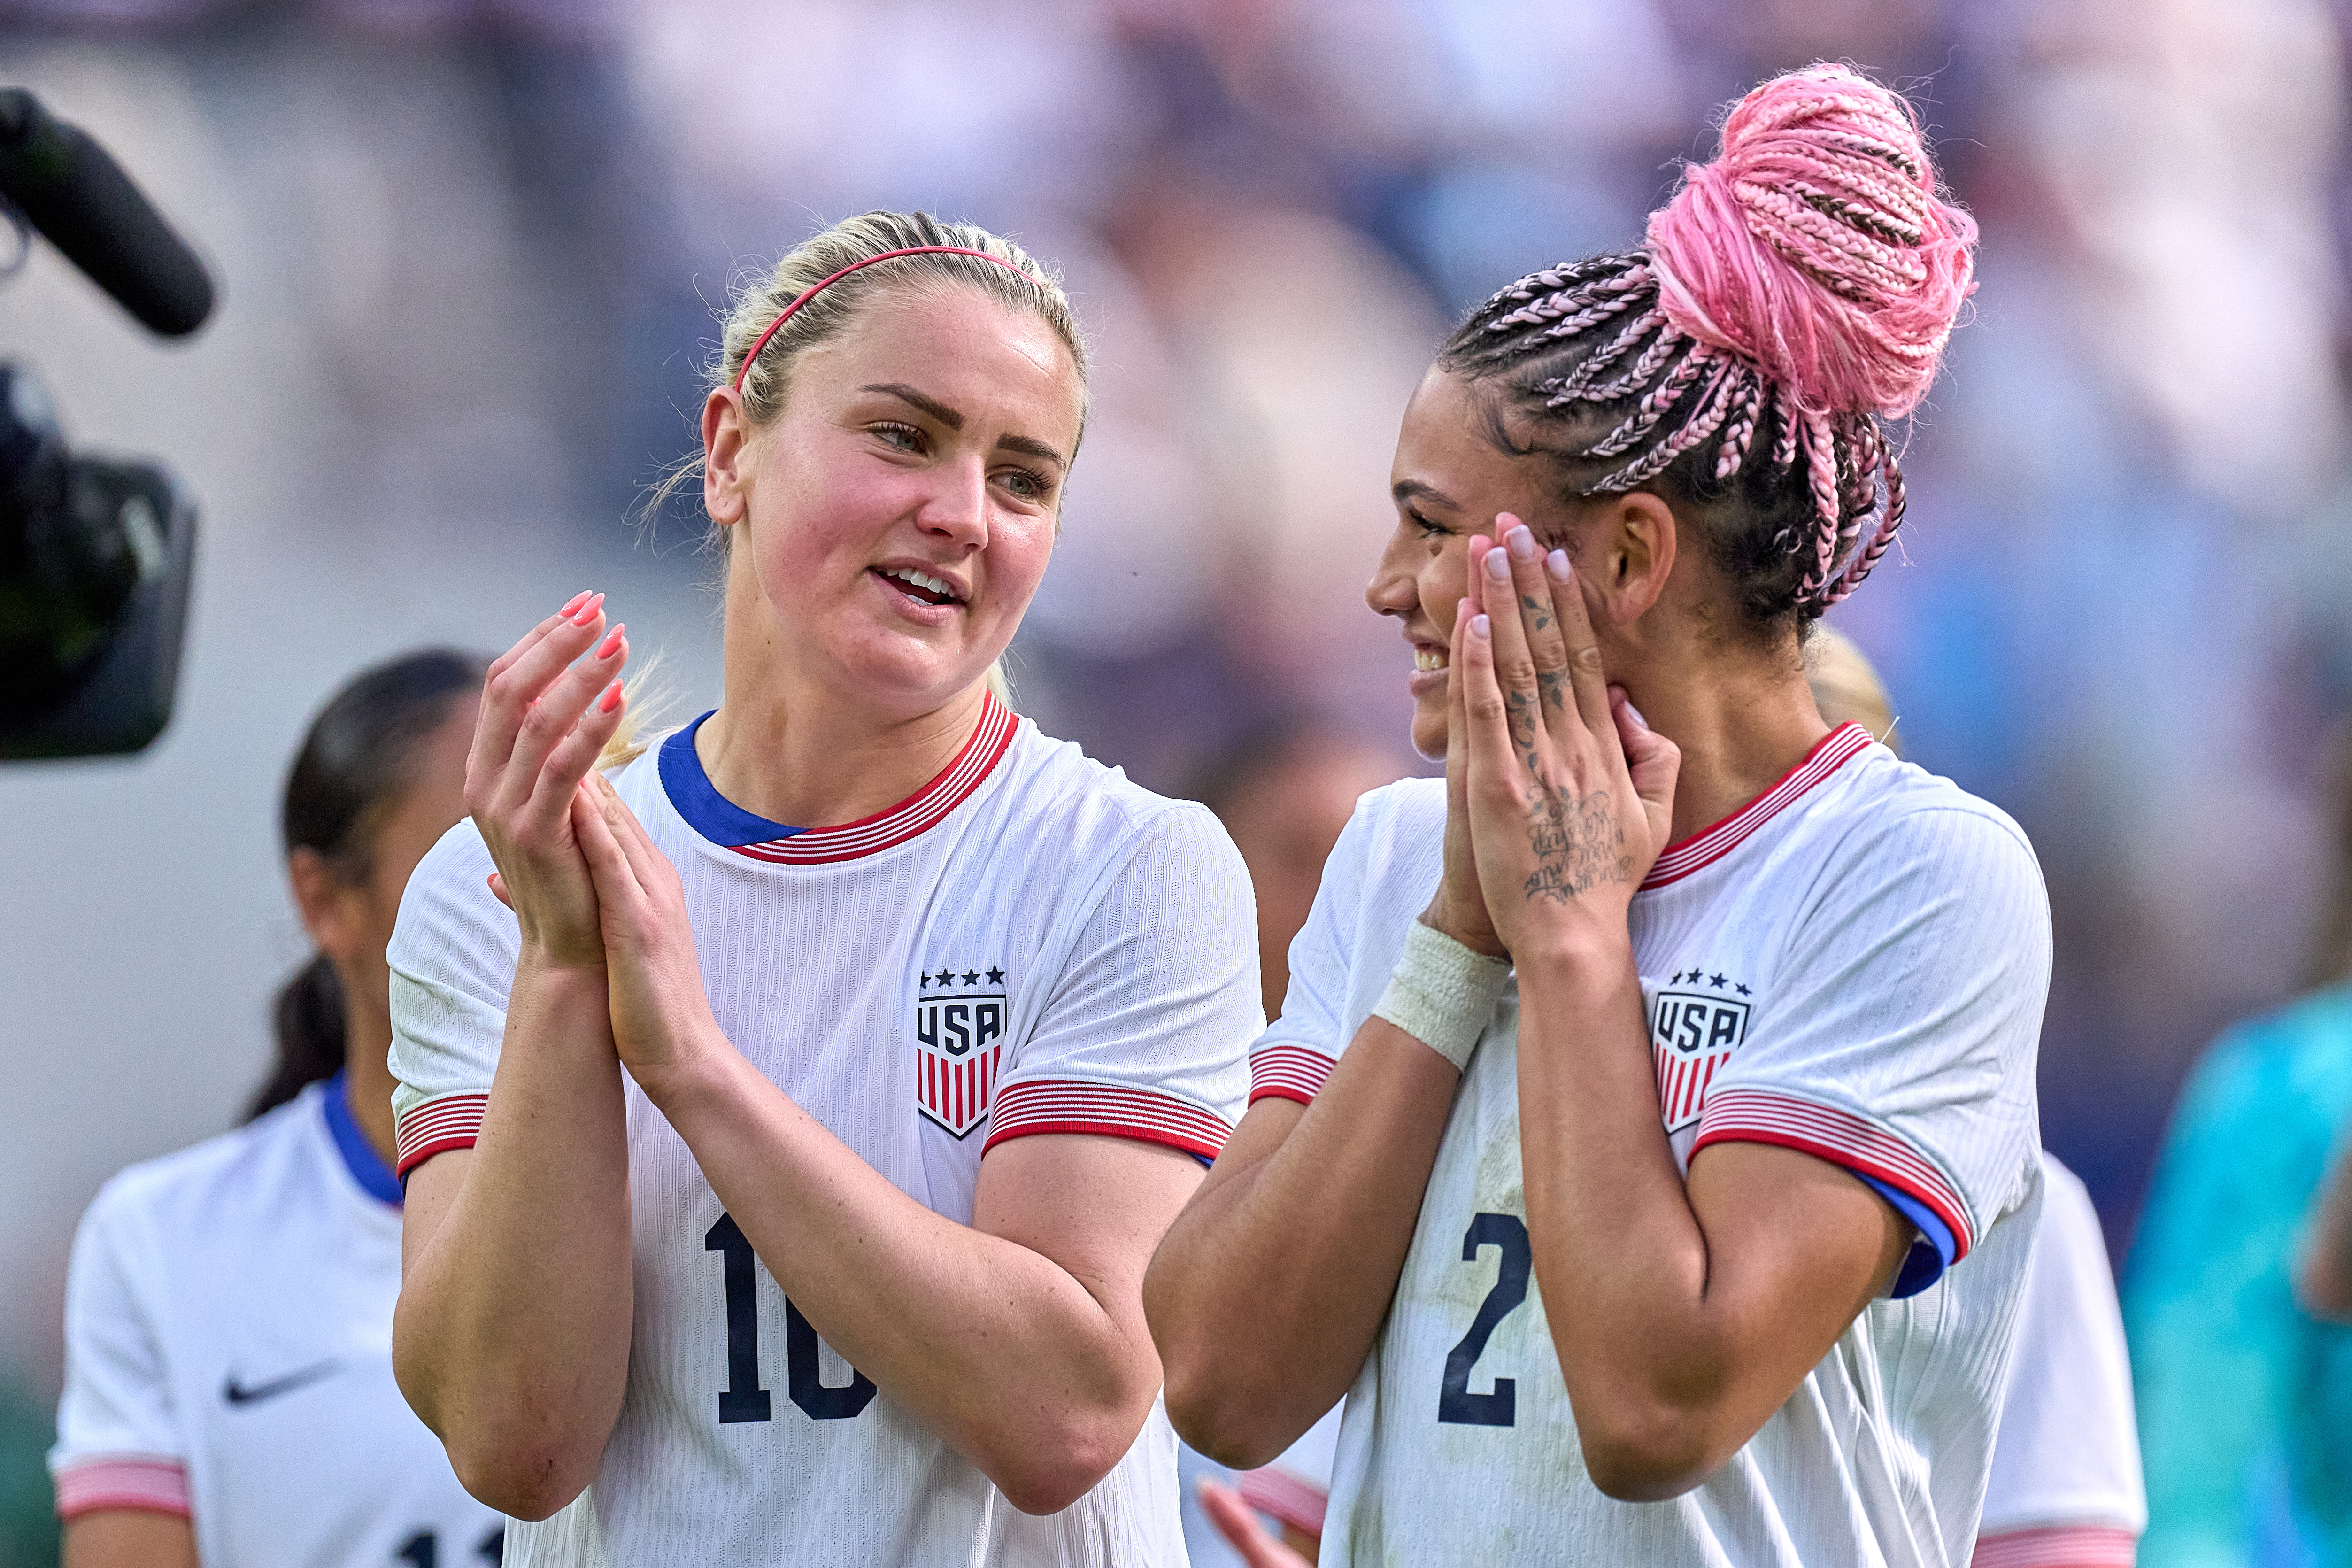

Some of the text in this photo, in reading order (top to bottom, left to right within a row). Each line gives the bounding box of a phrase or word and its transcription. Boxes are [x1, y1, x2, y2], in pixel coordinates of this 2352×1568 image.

[918, 1004, 1000, 1056] USA
[1658, 1002, 1739, 1053] USA
[1438, 1213, 1532, 1427] 2
